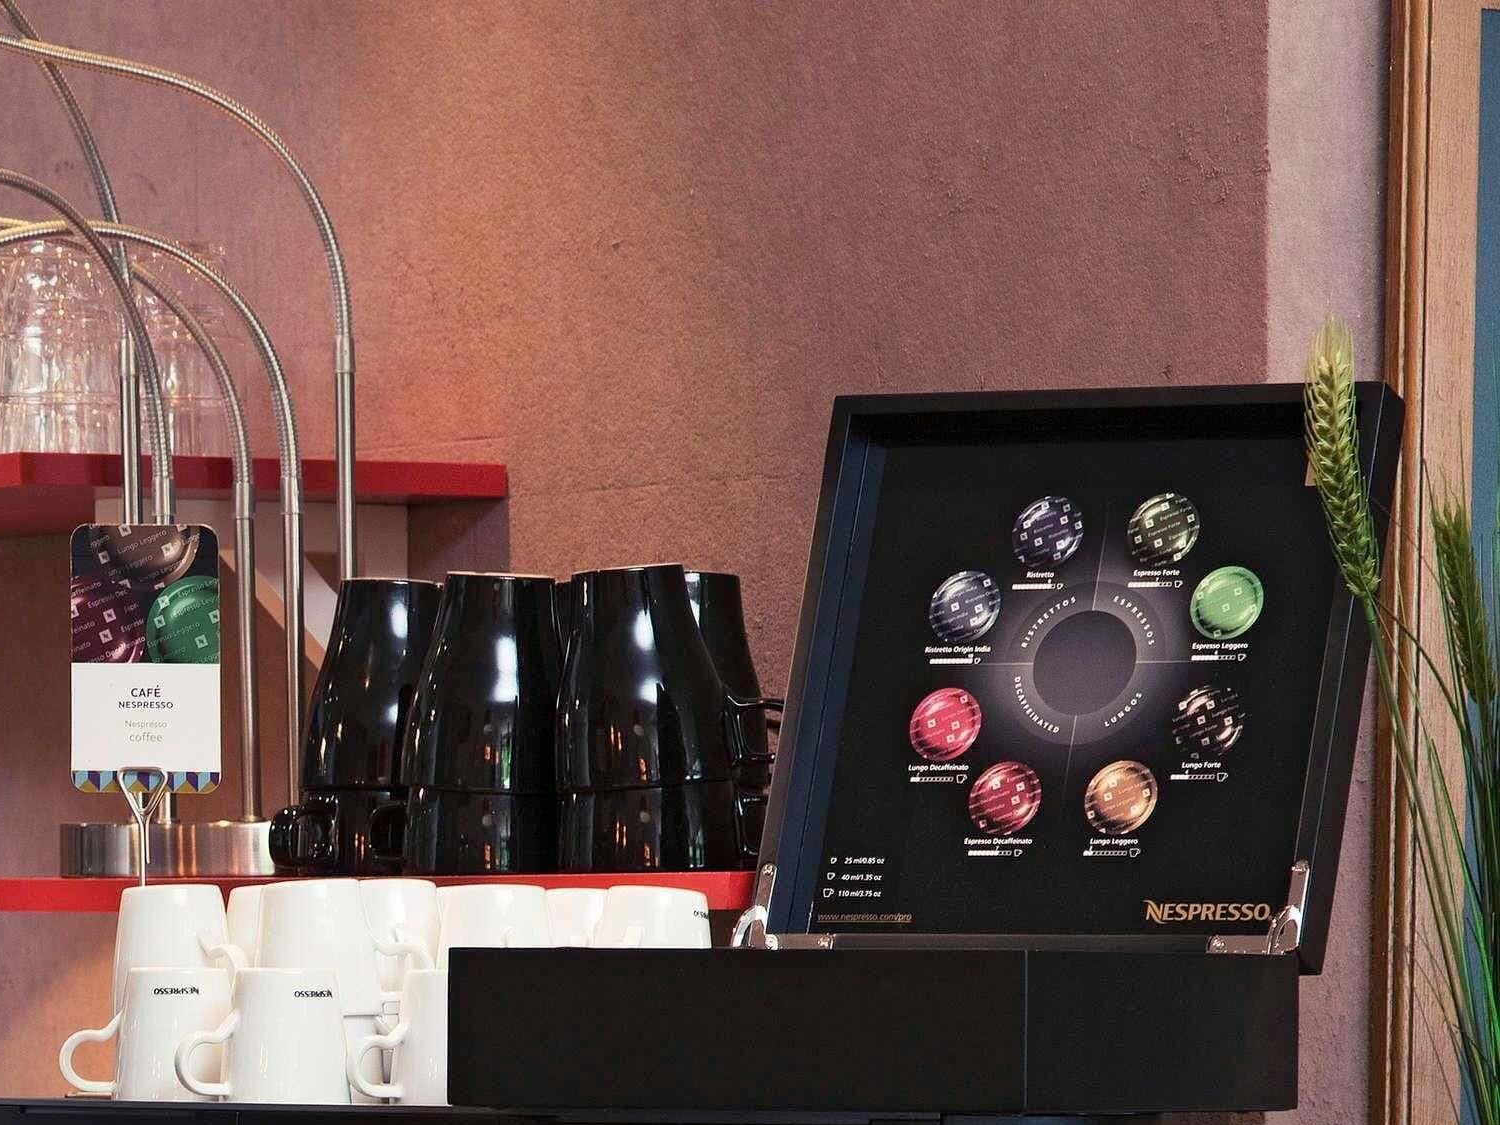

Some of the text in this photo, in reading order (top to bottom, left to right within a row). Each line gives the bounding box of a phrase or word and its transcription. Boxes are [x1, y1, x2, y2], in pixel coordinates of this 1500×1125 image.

[1026, 571, 1055, 579] Ristretto
[1134, 568, 1180, 577] Espresso Forte
[1020, 596, 1077, 648] RISTRETTOS
[1113, 595, 1155, 646] ESPRESSOS
[953, 646, 974, 655] Origin
[1191, 642, 1249, 651] Espresso Leggero
[130, 684, 161, 698] CAFÉ
[118, 701, 174, 709] NESPRESSO
[1014, 676, 1060, 734] DECAFFEINATED
[1104, 692, 1143, 727] LUNGOS
[124, 720, 168, 729] Nespresso
[129, 731, 163, 742] coffee
[908, 764, 969, 772] Lungo Decaffeinato
[1181, 761, 1222, 770] Lungo Forte
[963, 837, 1033, 846] Espresso Decaffeinato
[1090, 837, 1139, 846] Lungo Leggero
[1143, 900, 1272, 924] NESPRESSO
